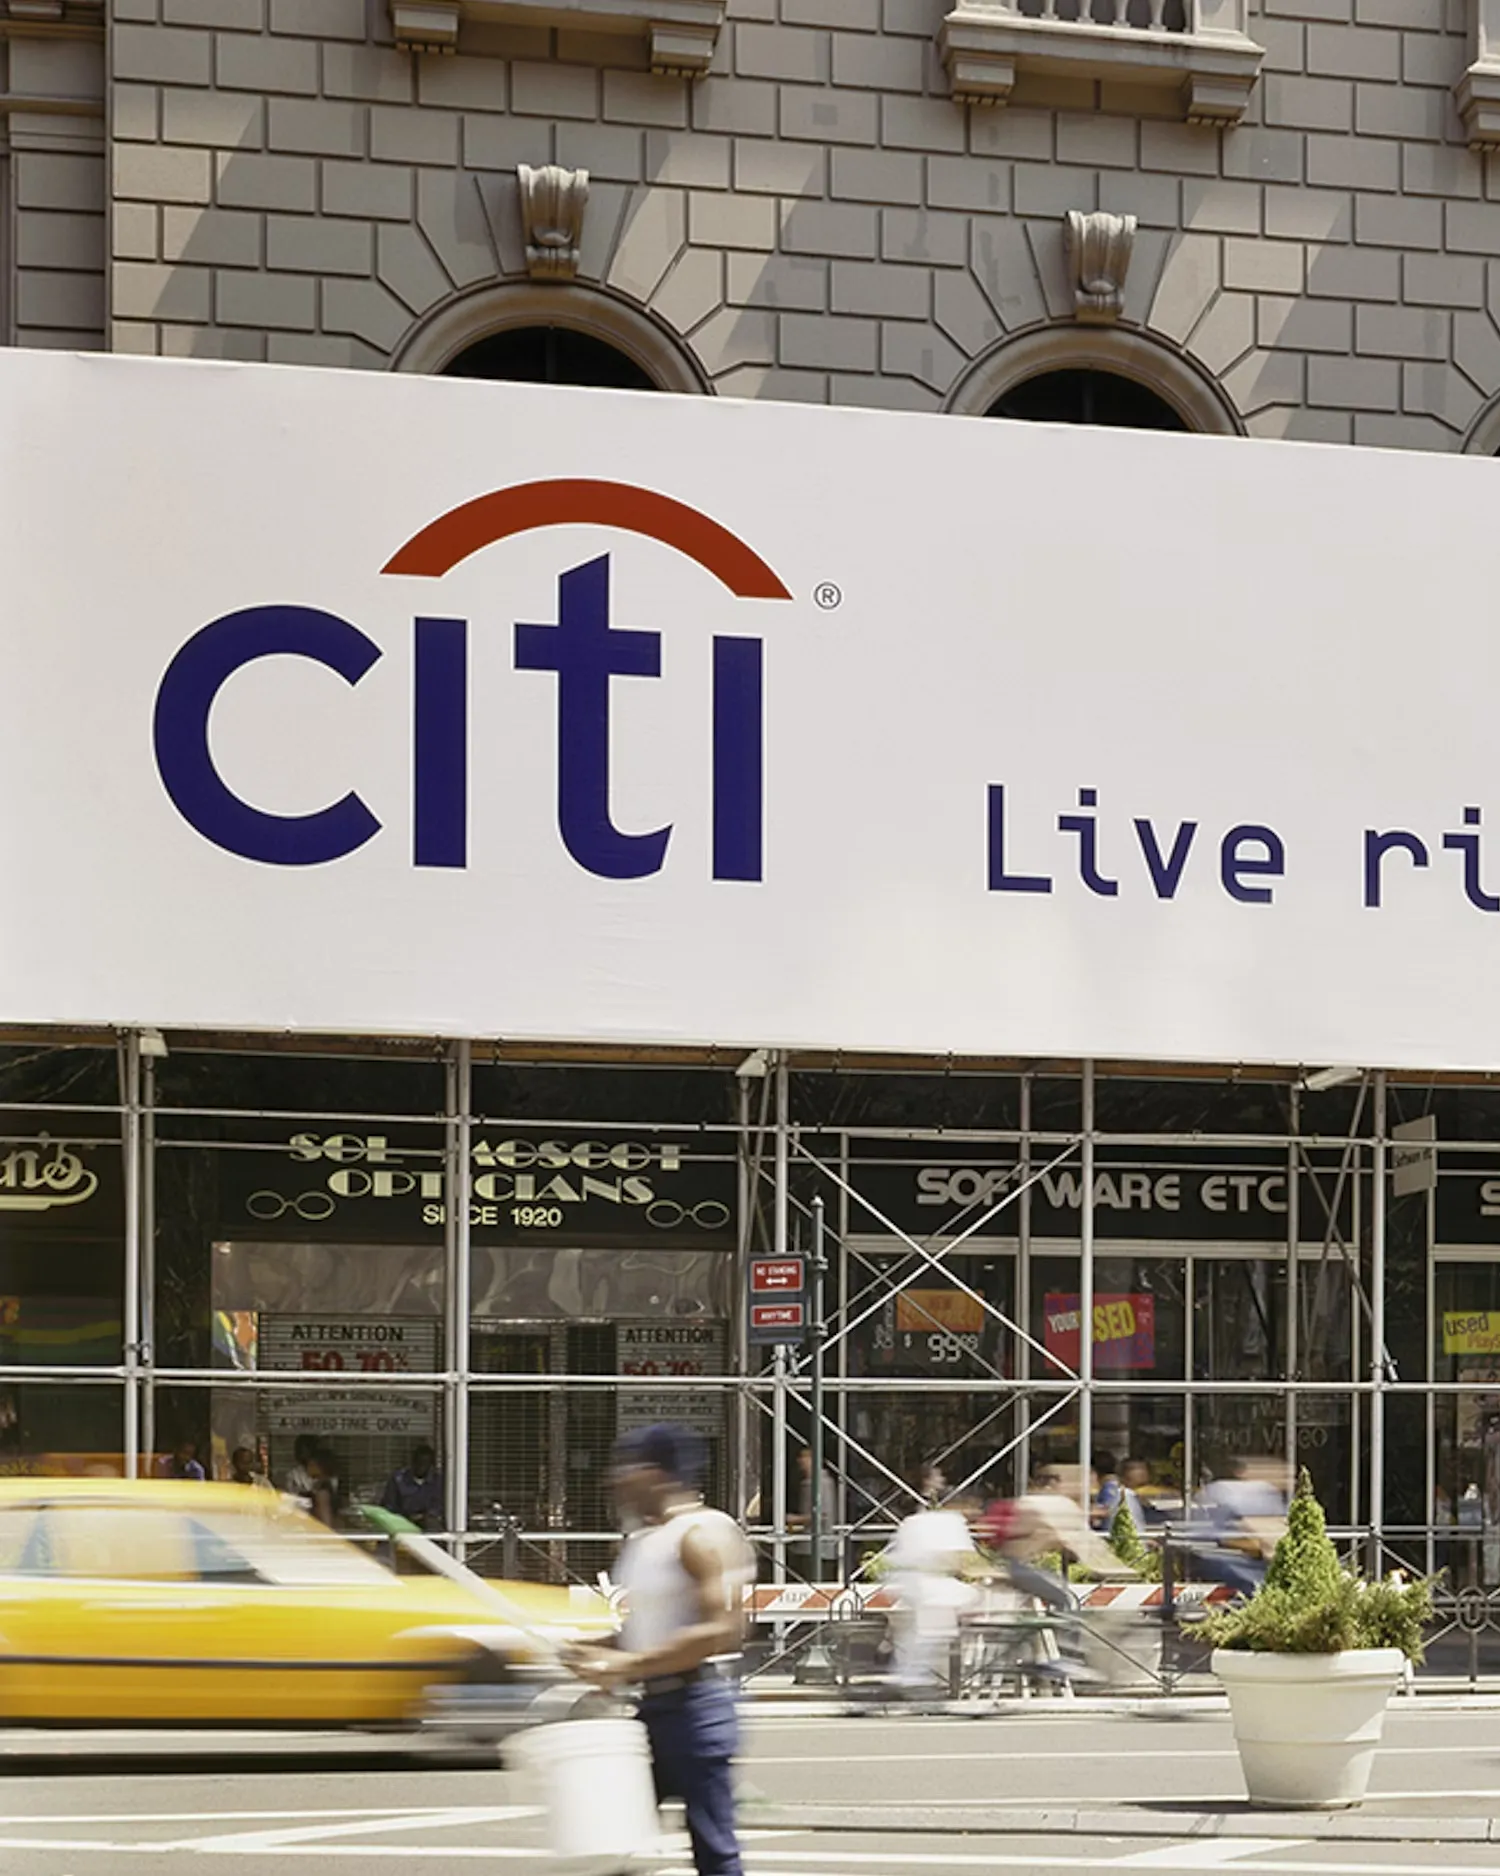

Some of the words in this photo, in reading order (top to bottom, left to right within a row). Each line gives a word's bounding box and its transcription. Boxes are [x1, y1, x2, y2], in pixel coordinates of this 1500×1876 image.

[153, 552, 764, 883] citi
[987, 784, 1285, 904] Live
[290, 1133, 404, 1162] SOL
[328, 1170, 655, 1205] OPTCIANS
[1201, 1175, 1288, 1212] ETC
[422, 1204, 498, 1226] SICE
[510, 1206, 562, 1228] 1920
[291, 1324, 404, 1342] ATTENTION
[625, 1327, 714, 1343] ATTENTION
[1076, 1300, 1136, 1342] SED
[1446, 1312, 1489, 1337] used
